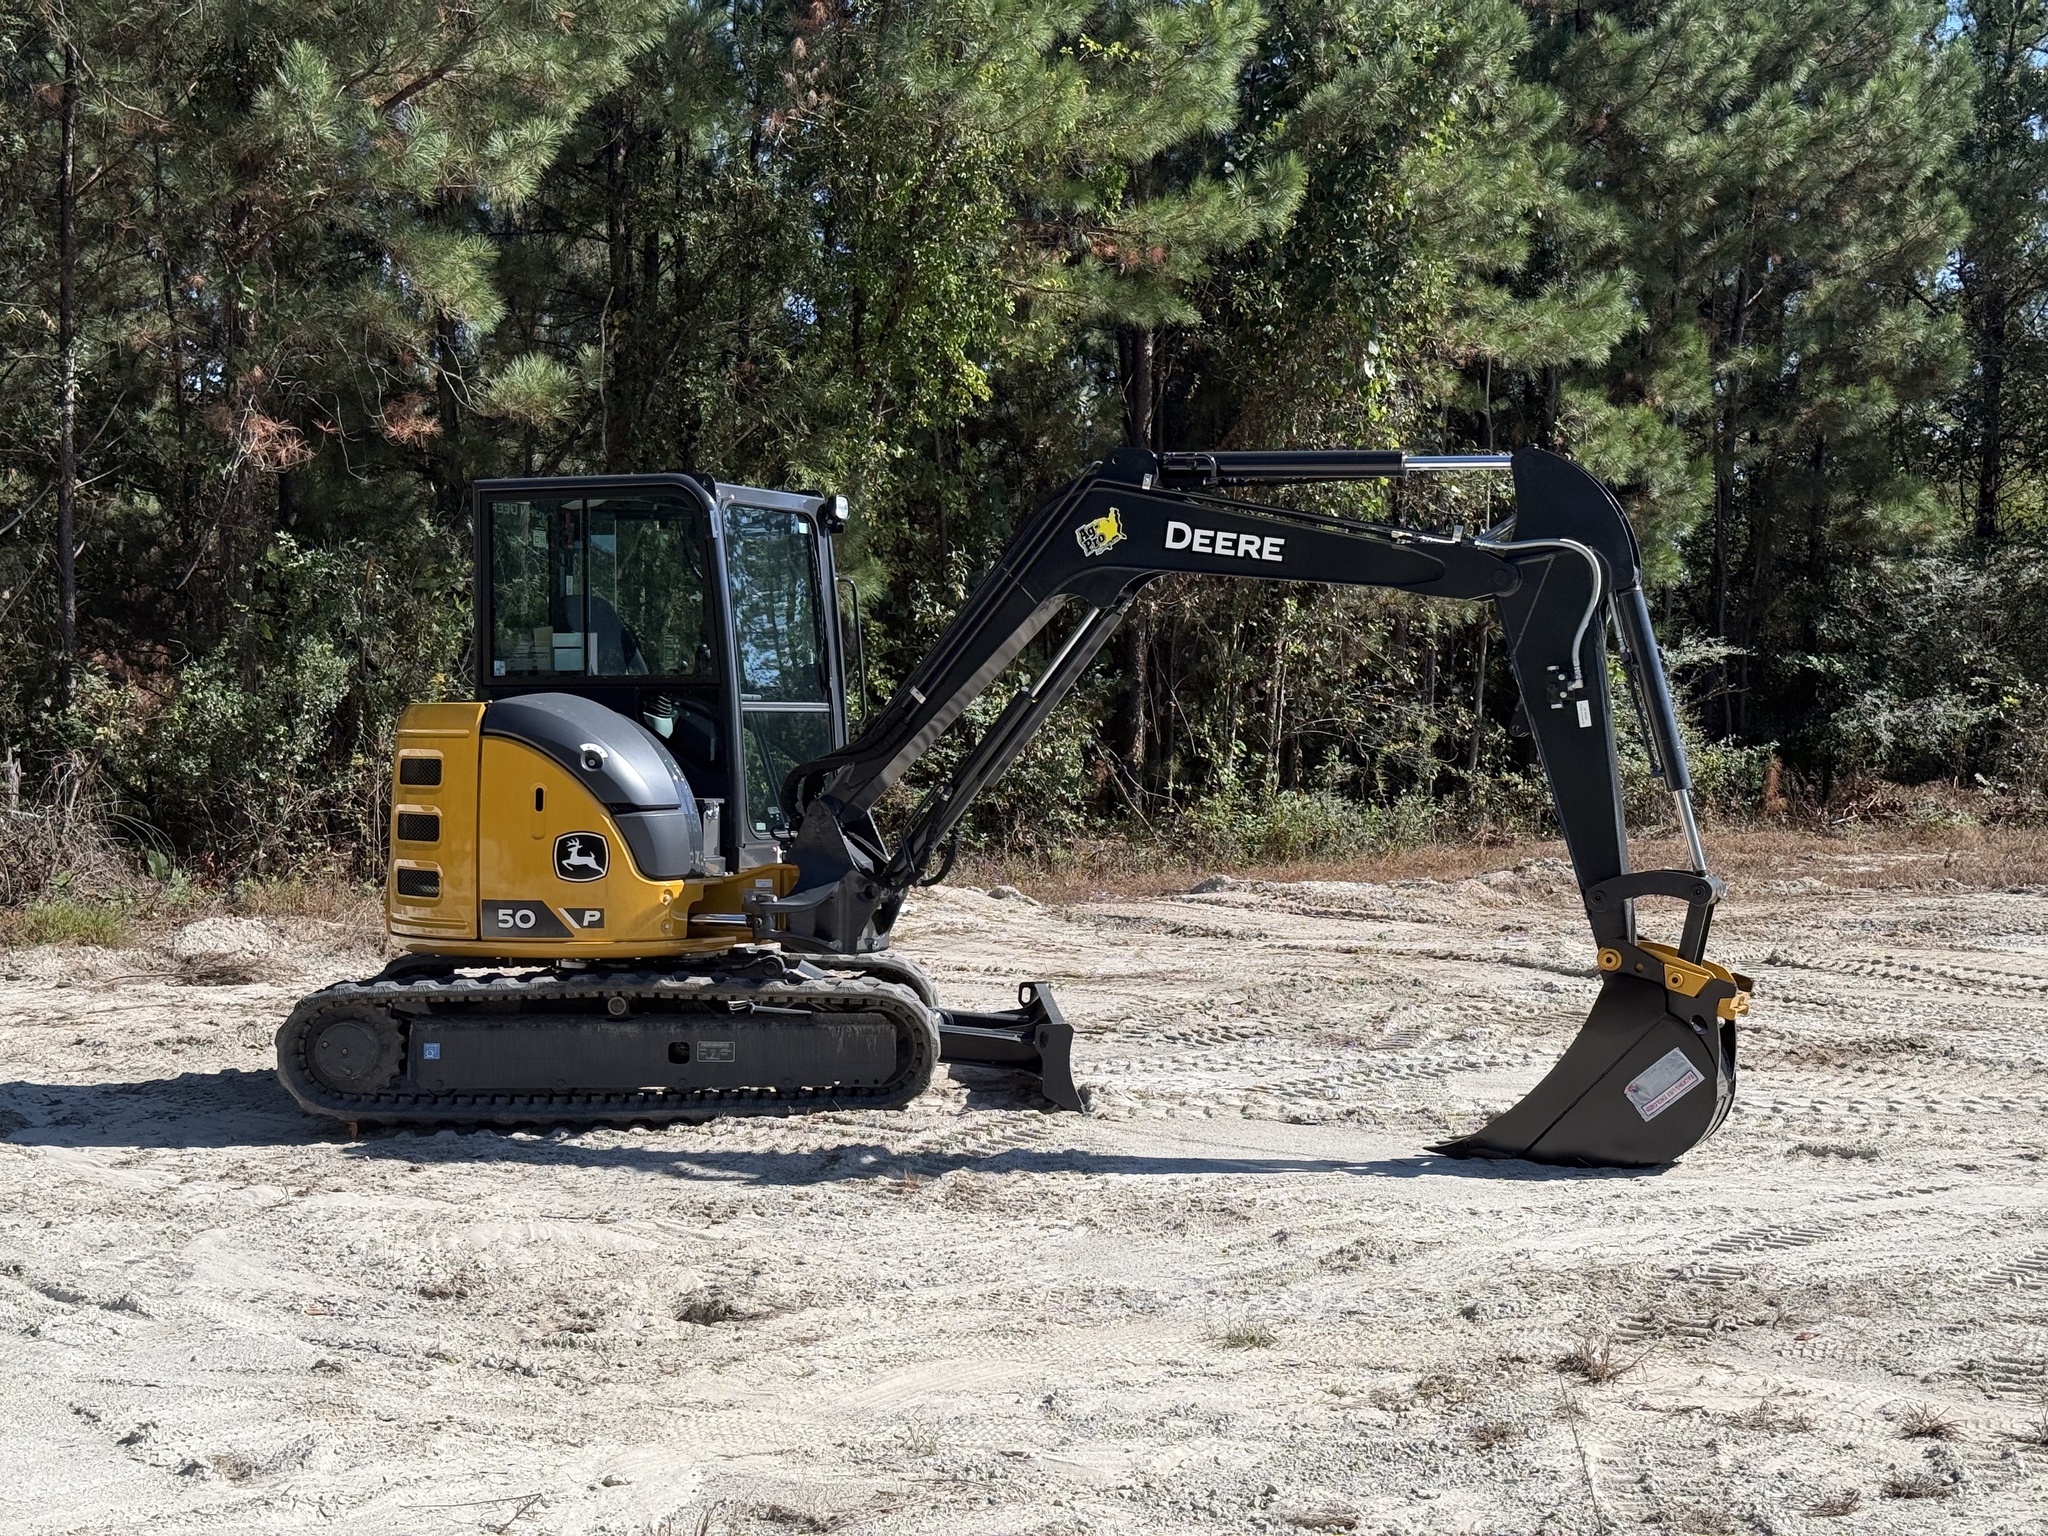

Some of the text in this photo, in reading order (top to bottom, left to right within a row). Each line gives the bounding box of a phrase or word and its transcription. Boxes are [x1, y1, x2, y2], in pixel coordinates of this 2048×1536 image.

[1079, 524, 1099, 542] Ag-
[1165, 521, 1285, 562] DEERE
[1084, 534, 1105, 552] Pro
[497, 909, 601, 929] 50 P
